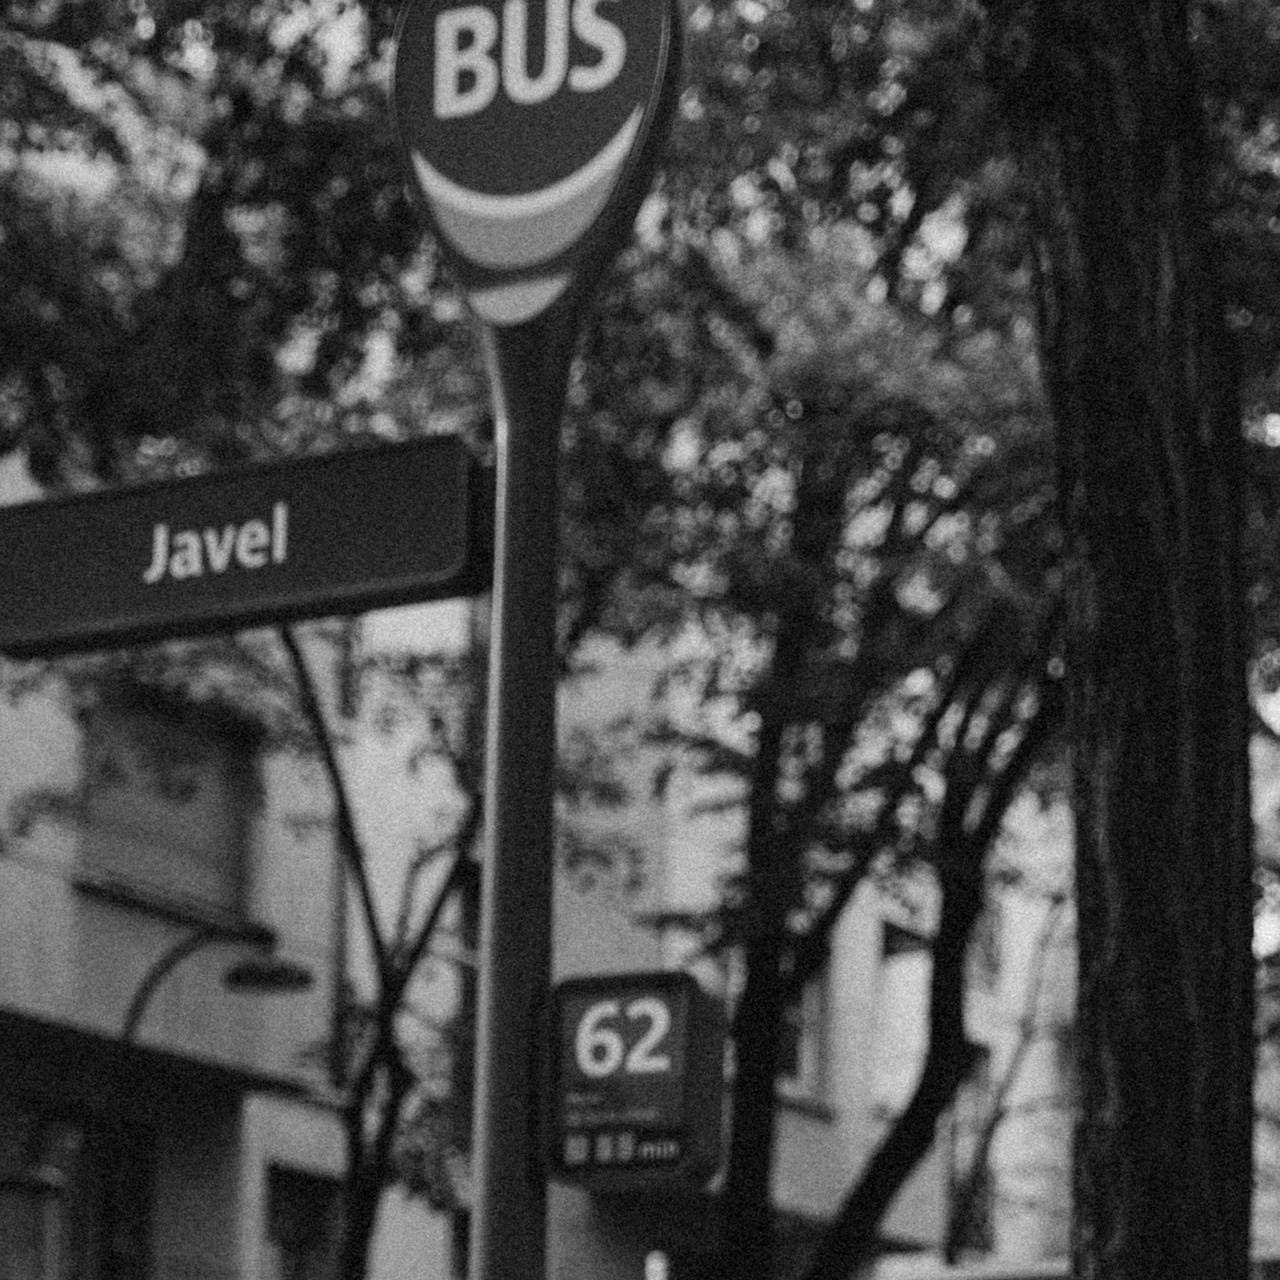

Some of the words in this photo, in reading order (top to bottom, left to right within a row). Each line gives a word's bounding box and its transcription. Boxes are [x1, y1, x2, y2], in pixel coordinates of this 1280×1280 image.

[433, 0, 627, 118] BUS
[142, 500, 290, 585] Javel
[575, 996, 672, 1078] 62
